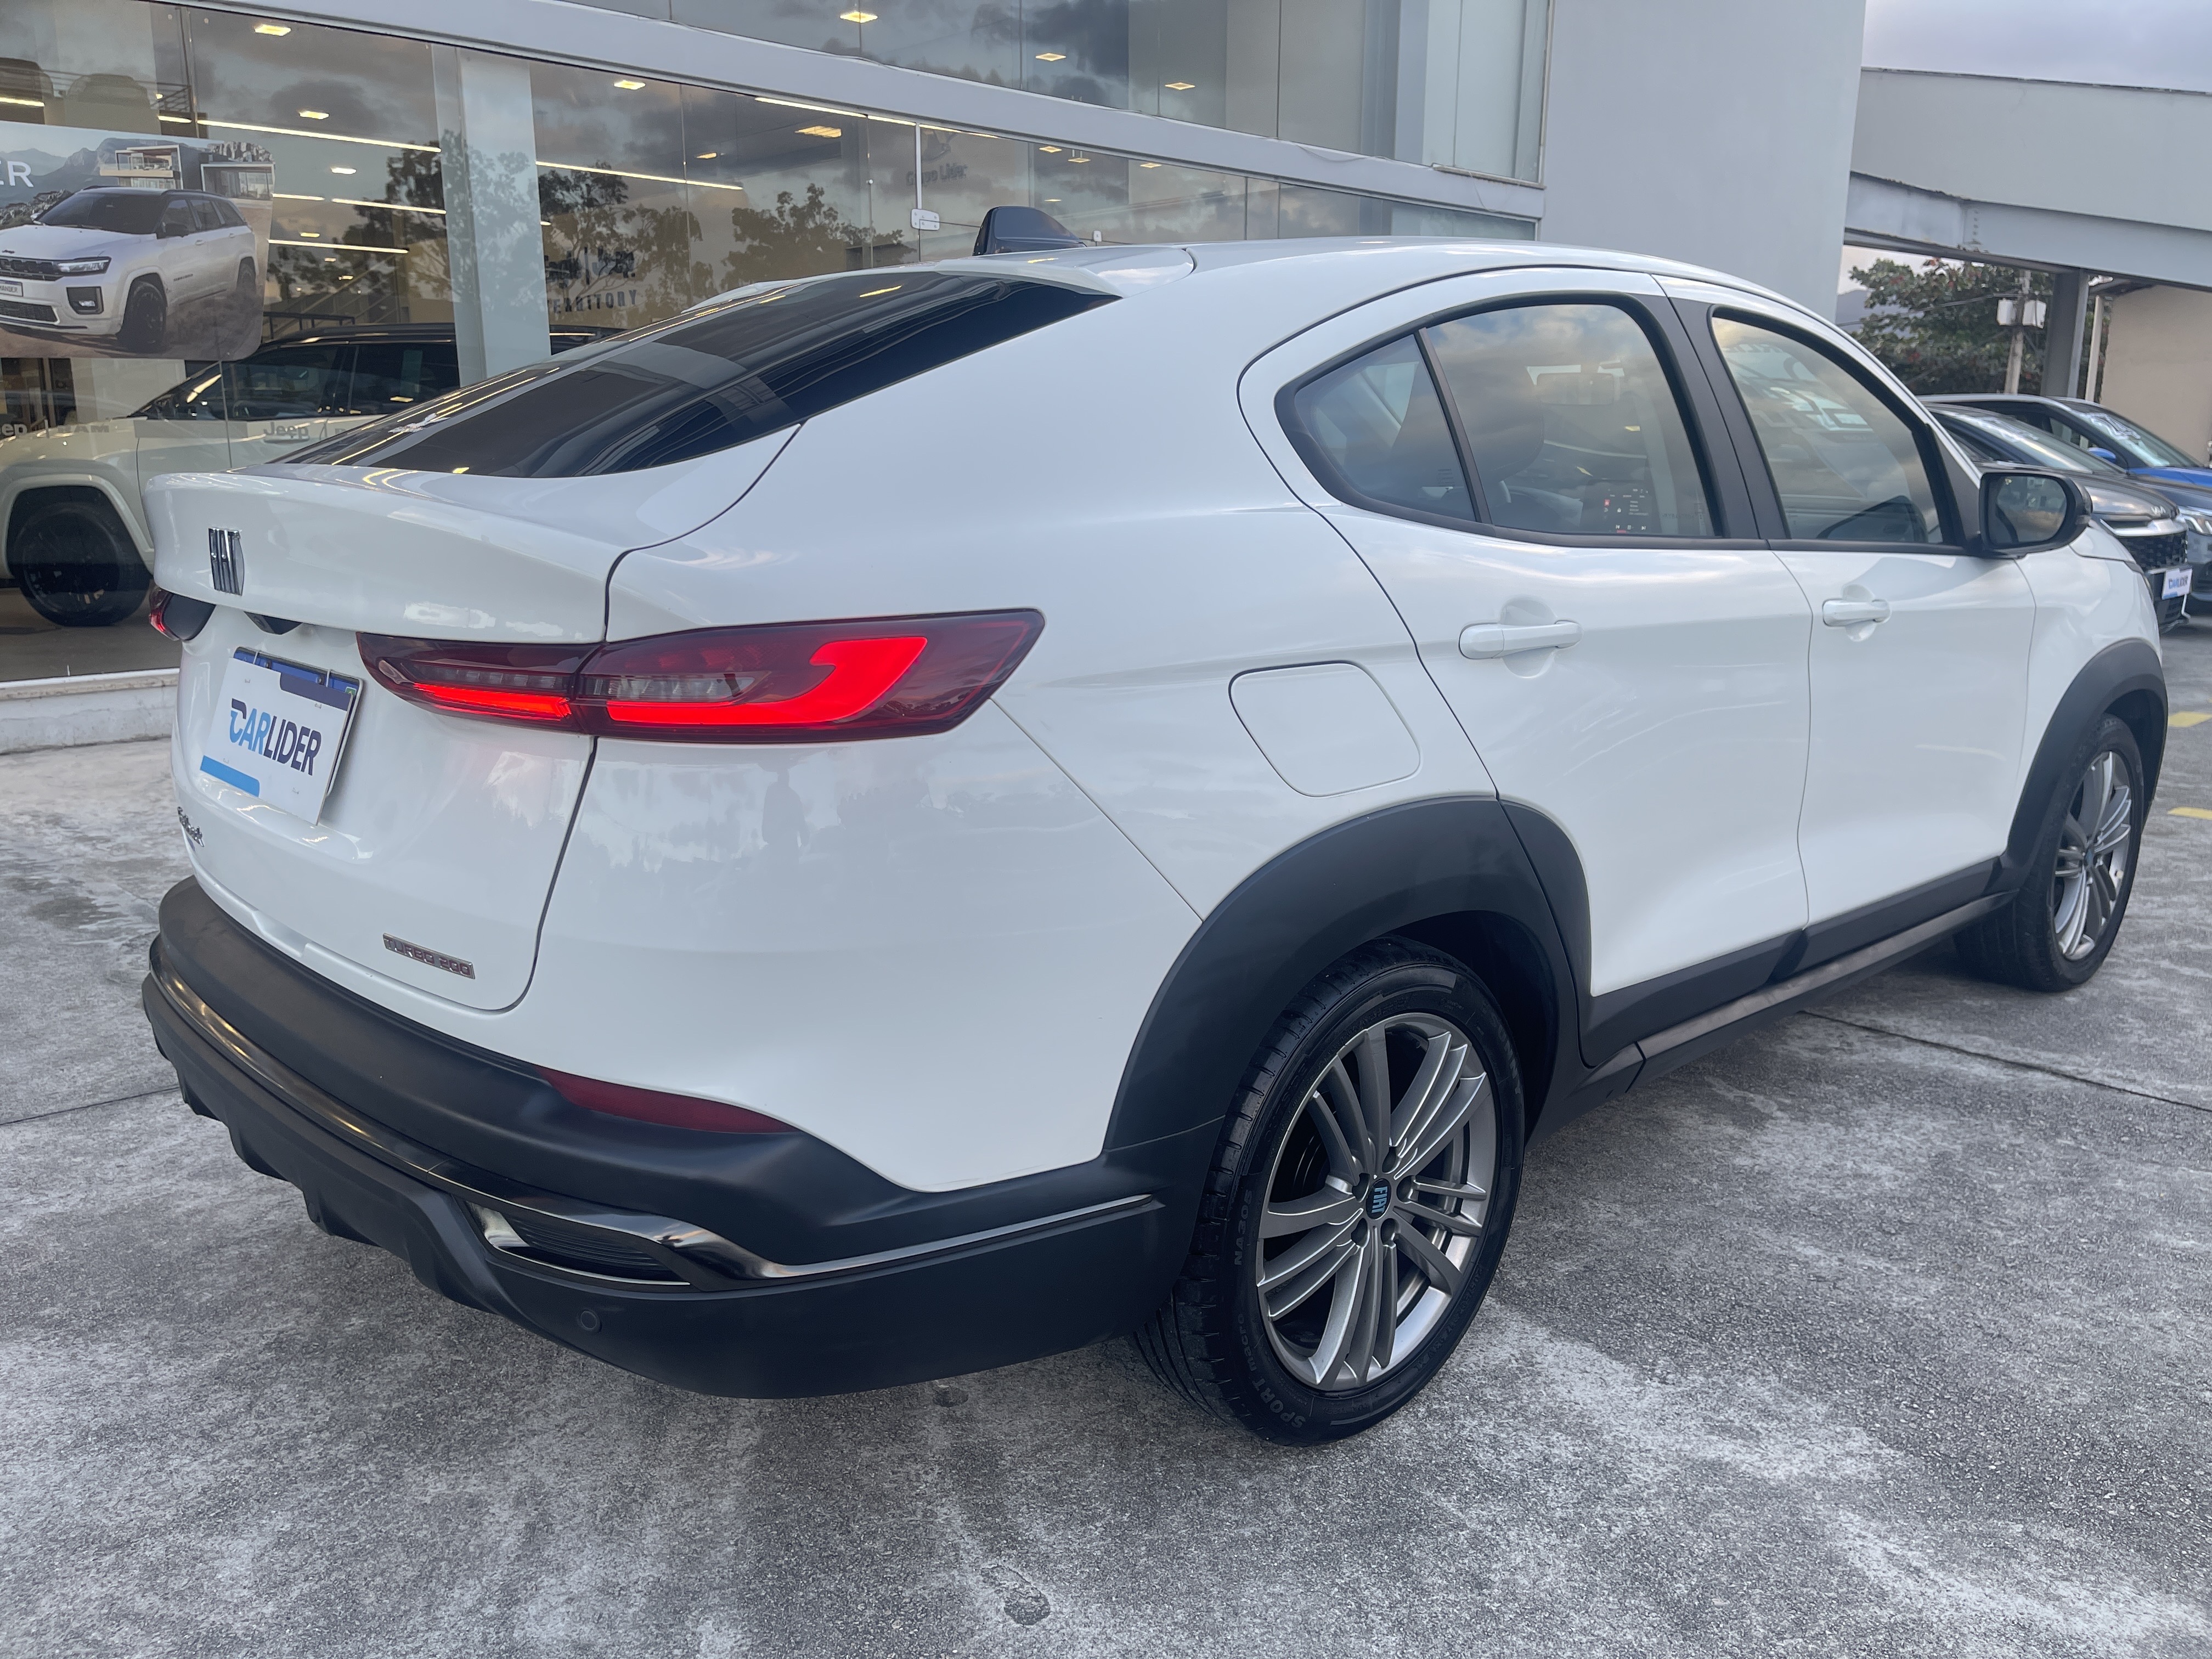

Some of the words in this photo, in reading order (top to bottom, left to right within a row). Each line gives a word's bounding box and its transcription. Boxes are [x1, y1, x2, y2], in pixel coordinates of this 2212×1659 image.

[0, 160, 34, 187] R
[548, 290, 637, 314] ERRITORY
[263, 421, 309, 439] Jeep
[230, 698, 321, 776] CARLIDER
[383, 938, 435, 964] TURBO
[438, 956, 471, 976] 200
[1372, 1186, 1388, 1213] FIAT
[1234, 1189, 1252, 1265] NA305
[1238, 1313, 1257, 1372] macro
[1252, 1376, 1306, 1428] SPORT
